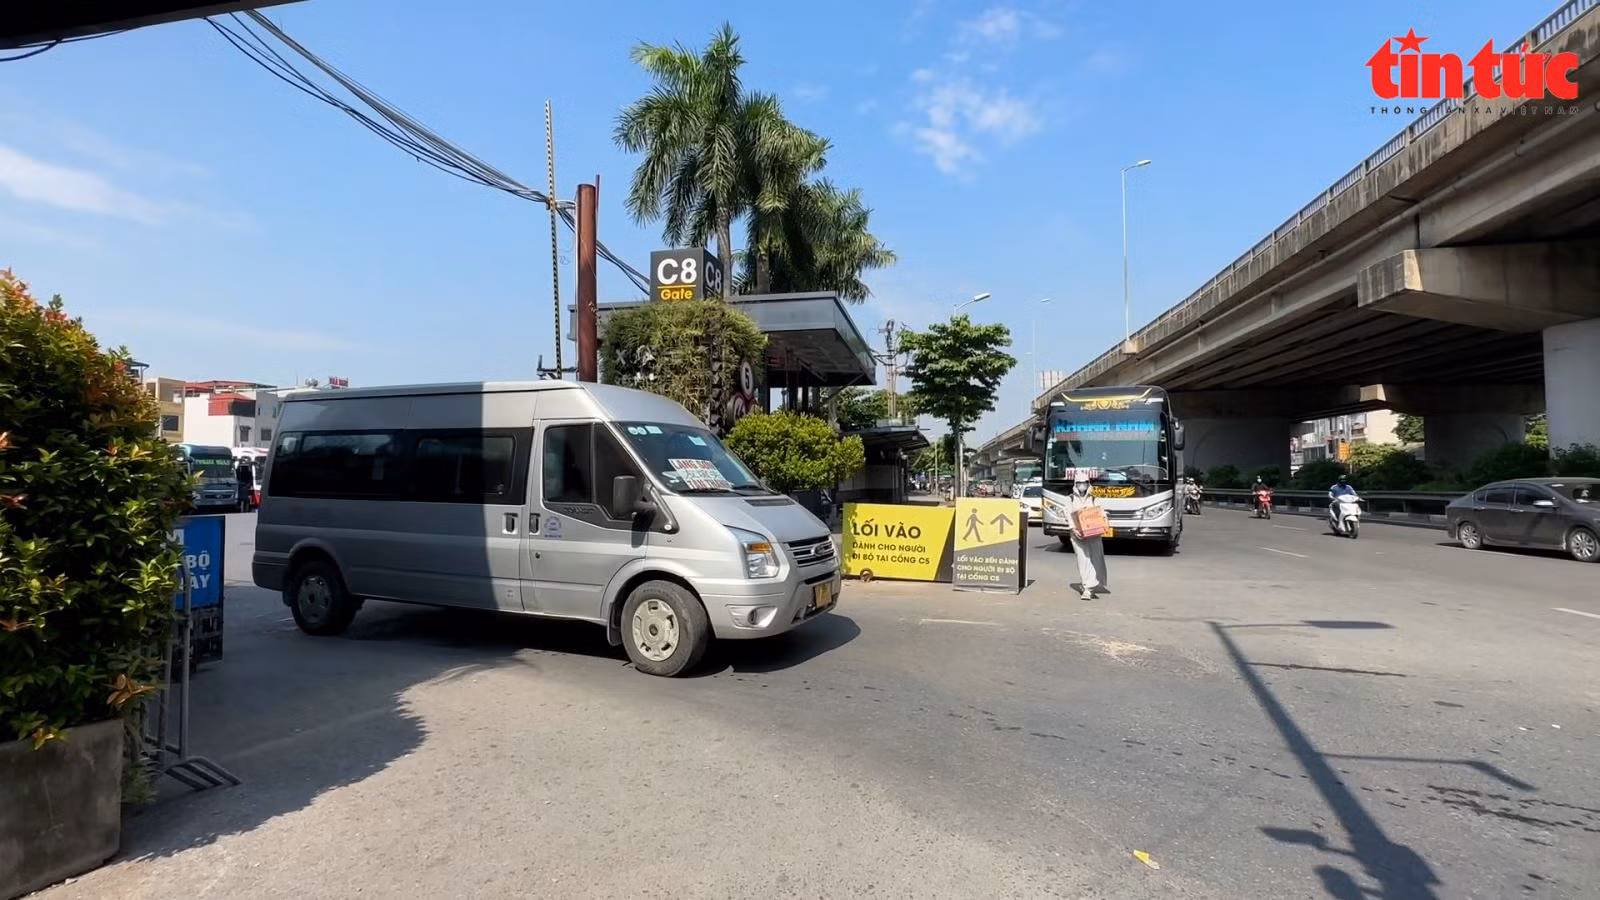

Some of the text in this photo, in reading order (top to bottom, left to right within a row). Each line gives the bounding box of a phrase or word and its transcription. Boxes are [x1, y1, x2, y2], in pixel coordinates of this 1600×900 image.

[657, 257, 698, 285] C8
[705, 260, 722, 294] C8
[660, 288, 693, 300] Gate
[853, 518, 921, 539] LỐI VÀO
[862, 553, 875, 563] BỘ
[877, 543, 897, 551] CHO
[898, 544, 926, 553] NGƯỜI
[185, 550, 211, 570] BỘ
